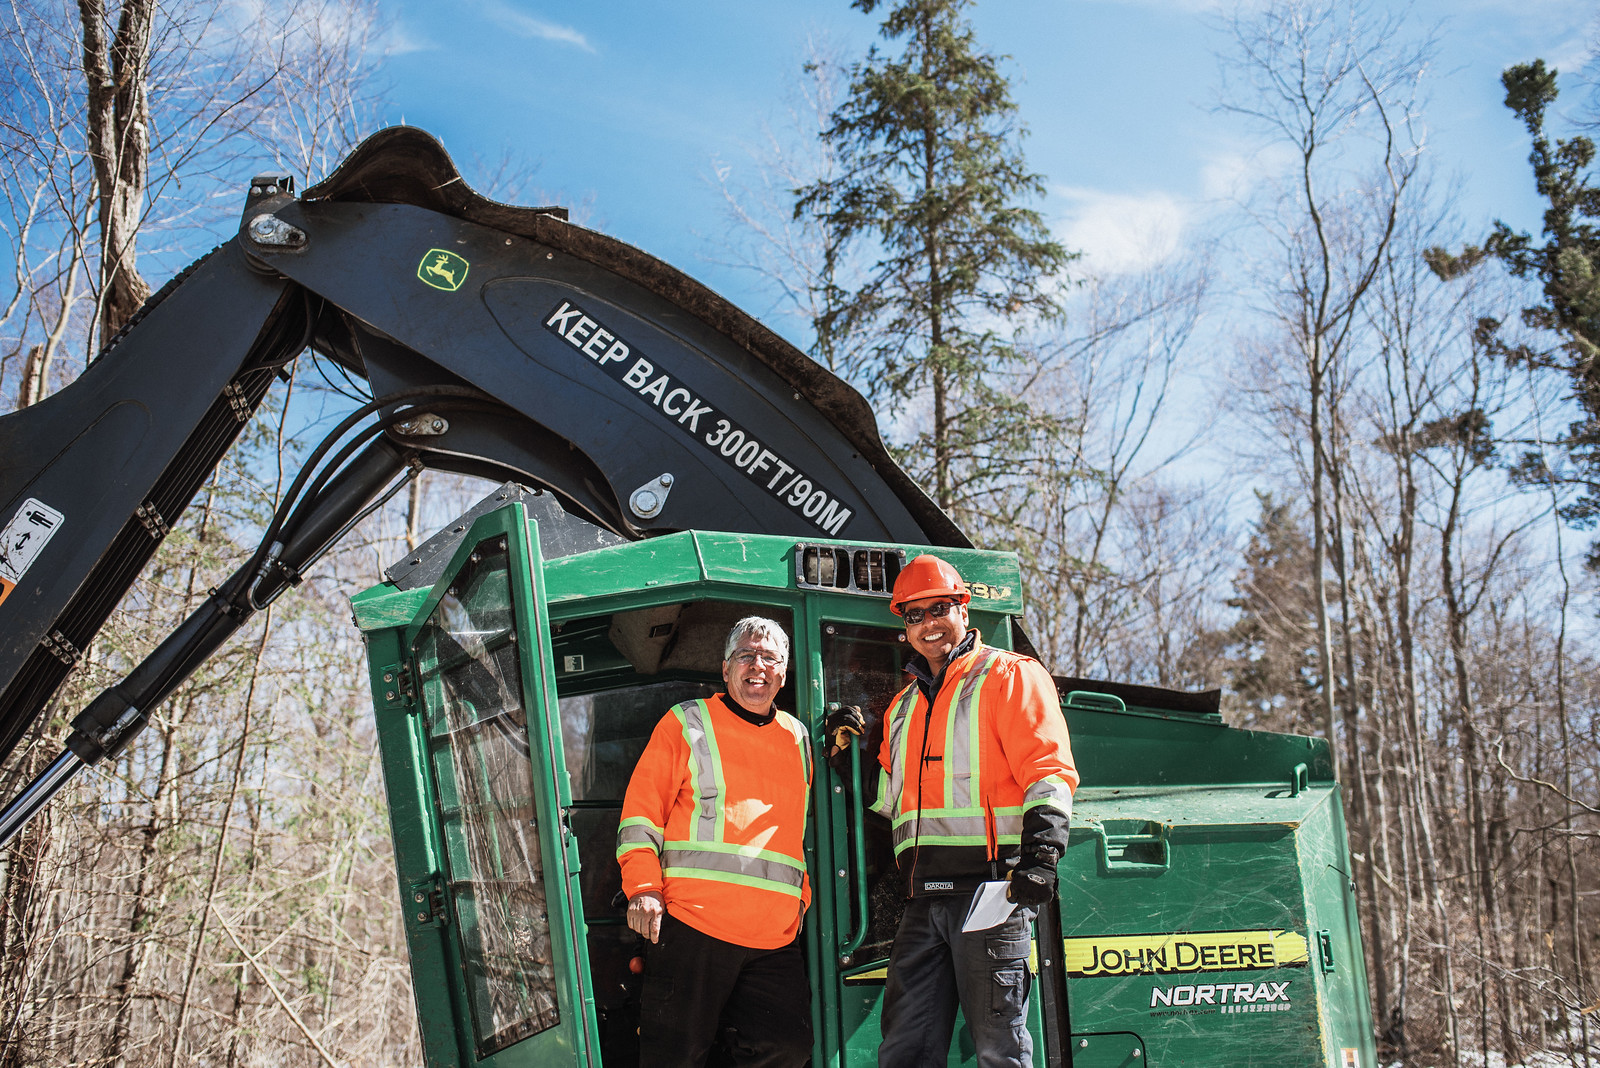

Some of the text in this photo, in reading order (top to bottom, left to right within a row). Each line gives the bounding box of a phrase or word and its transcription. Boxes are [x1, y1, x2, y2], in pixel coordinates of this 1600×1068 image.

[546, 302, 852, 536] KEEP BACK 300FT/90M
[925, 882, 953, 890] DAKOTA
[1082, 942, 1275, 971] JOHN DEERE
[1150, 981, 1292, 1008] NORTRAX
